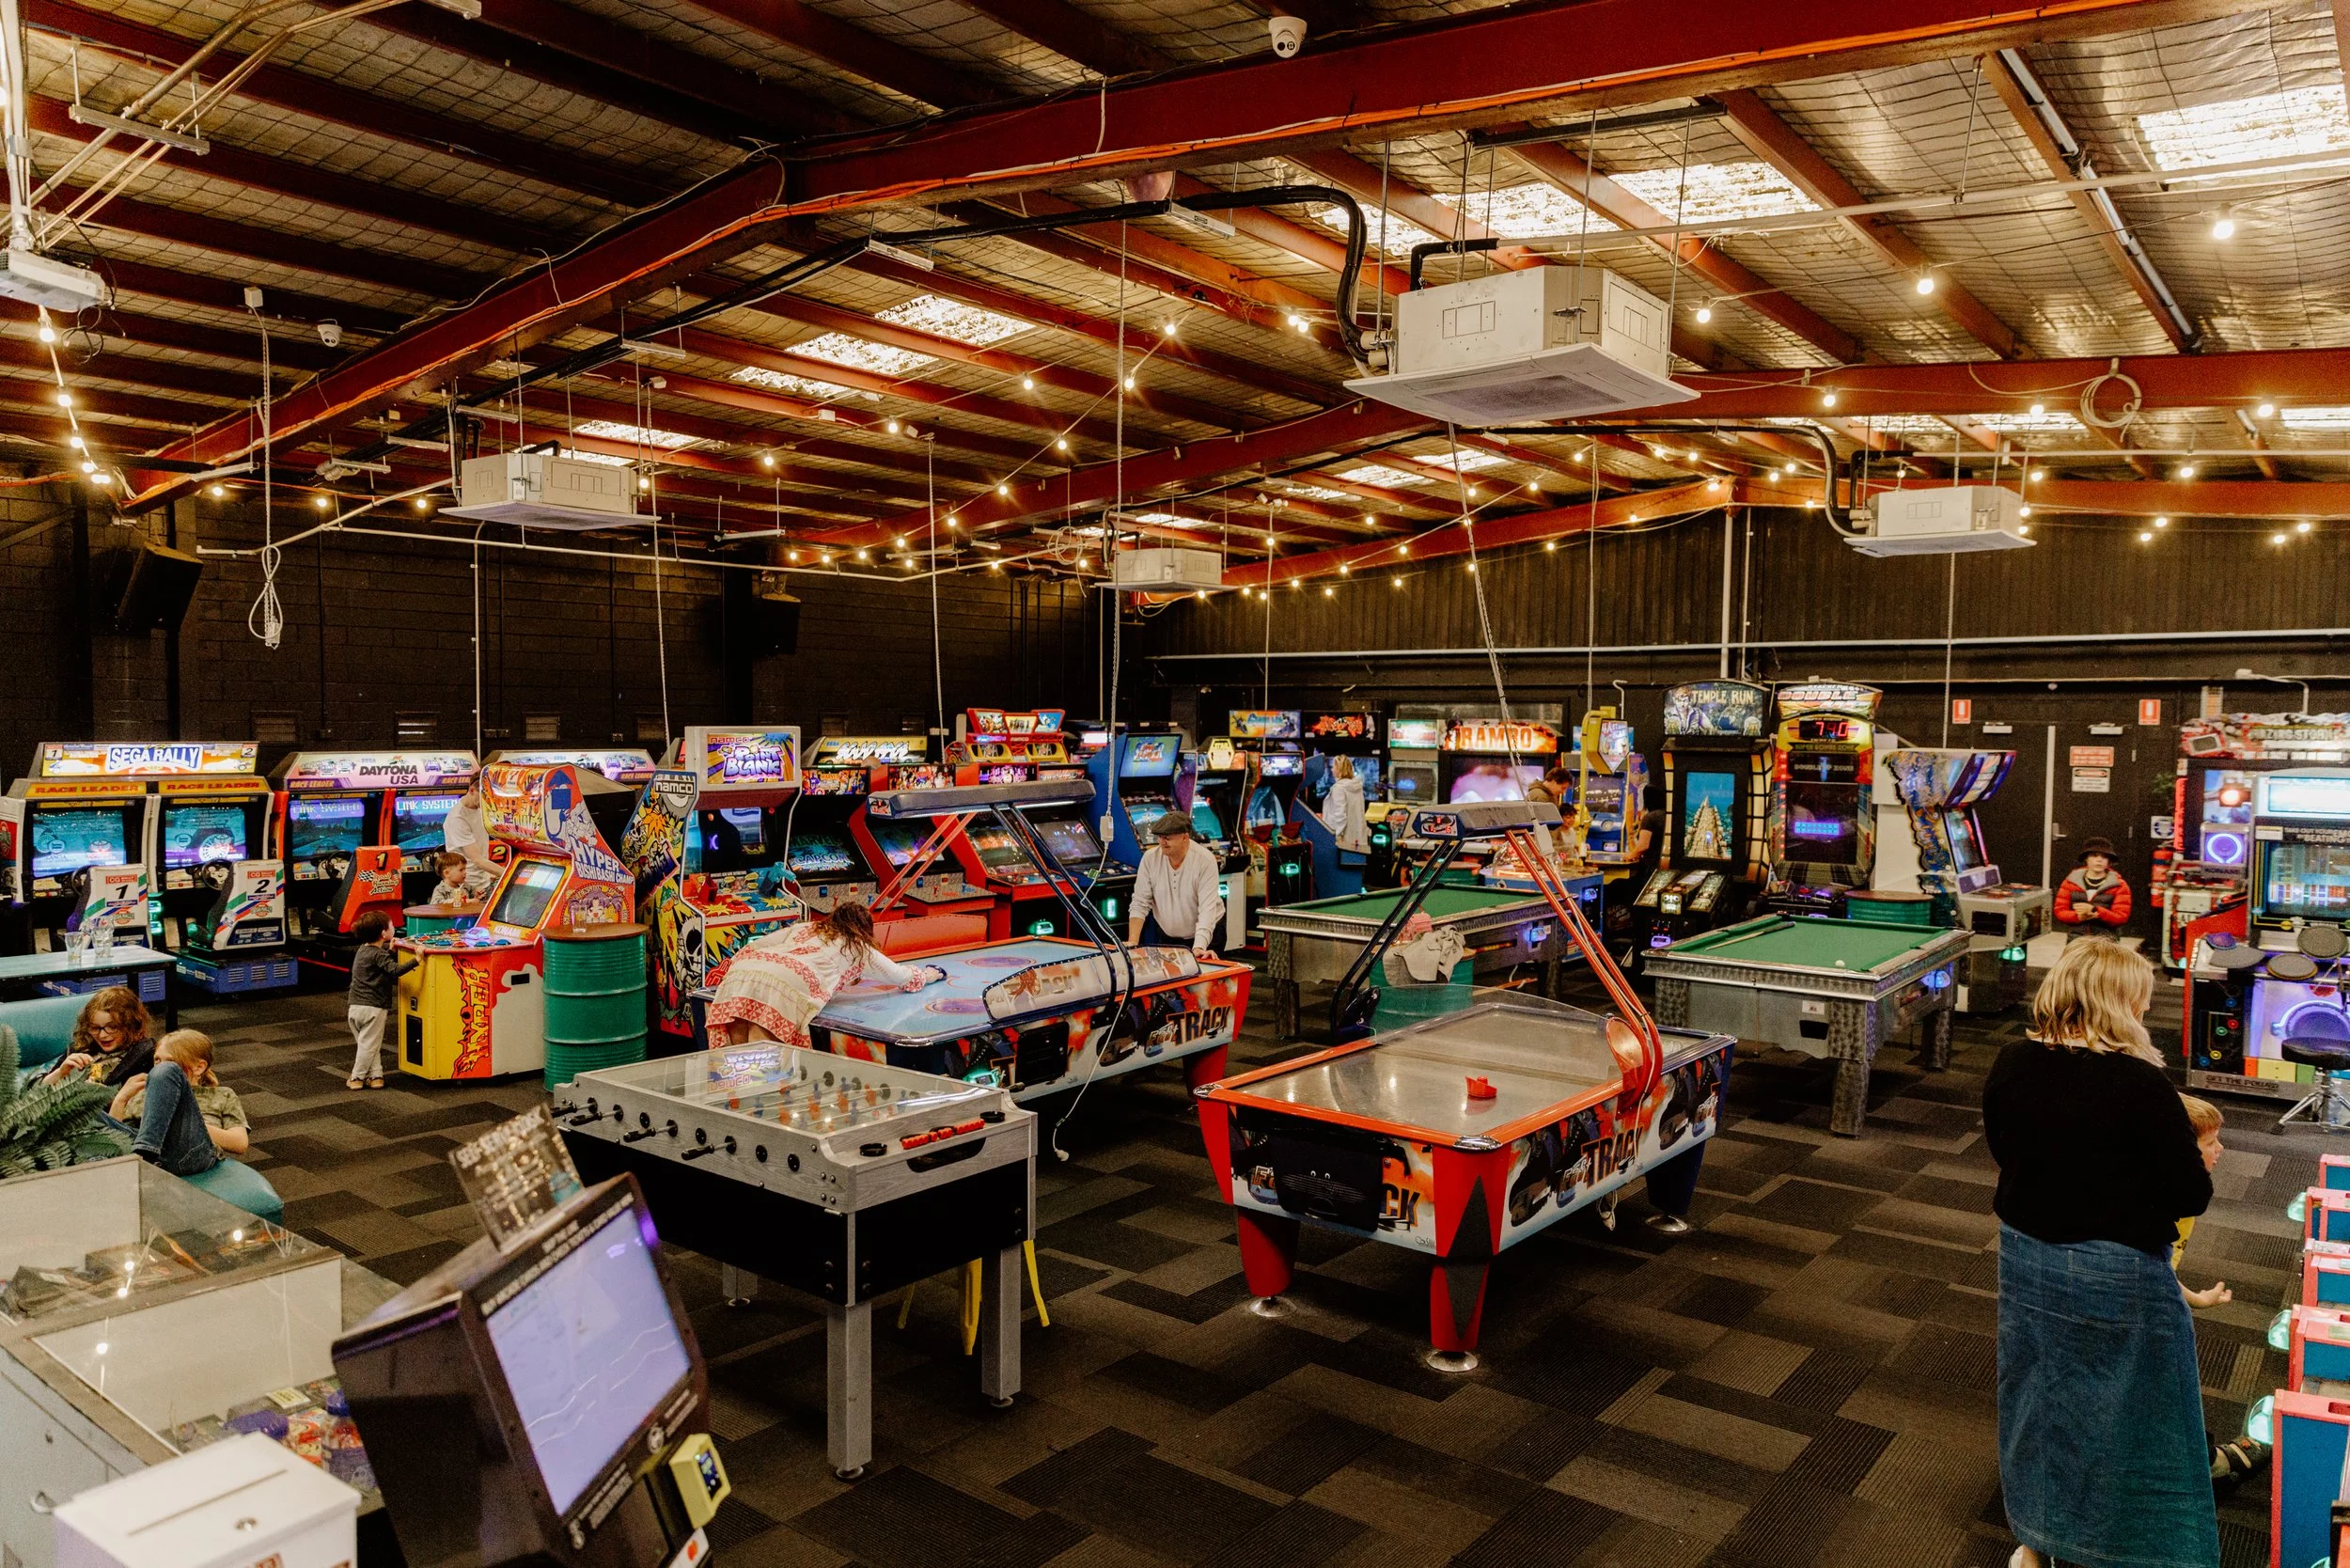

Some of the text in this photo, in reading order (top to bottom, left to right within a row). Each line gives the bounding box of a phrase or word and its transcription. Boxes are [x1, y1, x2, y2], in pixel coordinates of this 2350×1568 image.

[1691, 689, 1755, 704] TEMPLE RUN
[1460, 727, 1532, 748] RAMBO
[110, 747, 199, 770] SEGA RALLY
[359, 765, 417, 776] DAYTONA
[207, 781, 260, 790] LEADER
[390, 776, 418, 784] USA
[35, 784, 140, 793] RACE LEADER
[655, 781, 694, 794] namco
[292, 802, 361, 813] LINK SYSTEM
[395, 800, 419, 810] LINK
[376, 852, 387, 870] 1
[492, 846, 507, 862] 2
[570, 836, 620, 872] HYPER
[795, 853, 849, 866] CAPCOM
[116, 884, 129, 900] 1
[254, 879, 270, 893] 2
[494, 925, 523, 938] KONAMI
[1166, 1005, 1231, 1046] TRACK
[1580, 1126, 1644, 1189] TRACK
